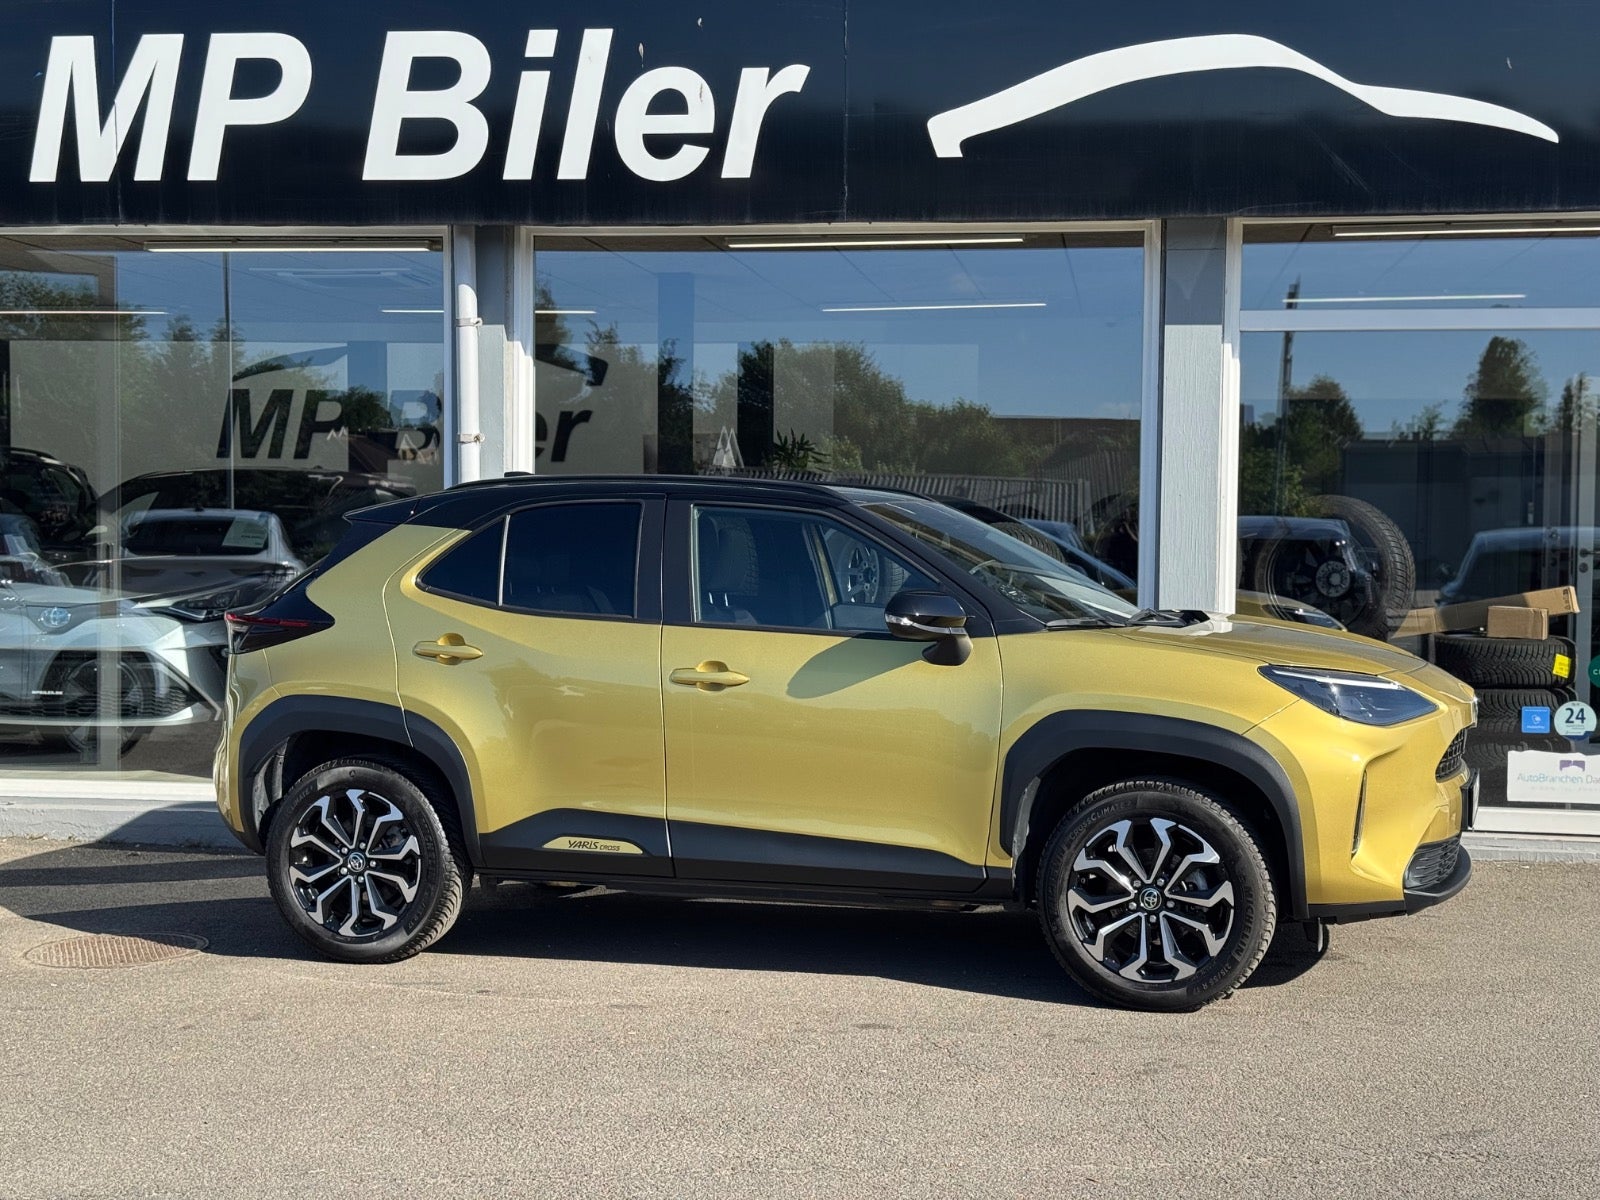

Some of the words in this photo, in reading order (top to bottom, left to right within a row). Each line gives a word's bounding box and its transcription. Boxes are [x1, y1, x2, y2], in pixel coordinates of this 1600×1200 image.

[29, 31, 313, 182] MP
[362, 28, 810, 182] Biler
[216, 388, 346, 460] MP
[1565, 707, 1586, 723] 24
[1517, 773, 1583, 784] AutoBranchen
[568, 840, 600, 850] YARIS
[600, 844, 621, 852] CROSS
[1234, 888, 1254, 957] MICHELIN
